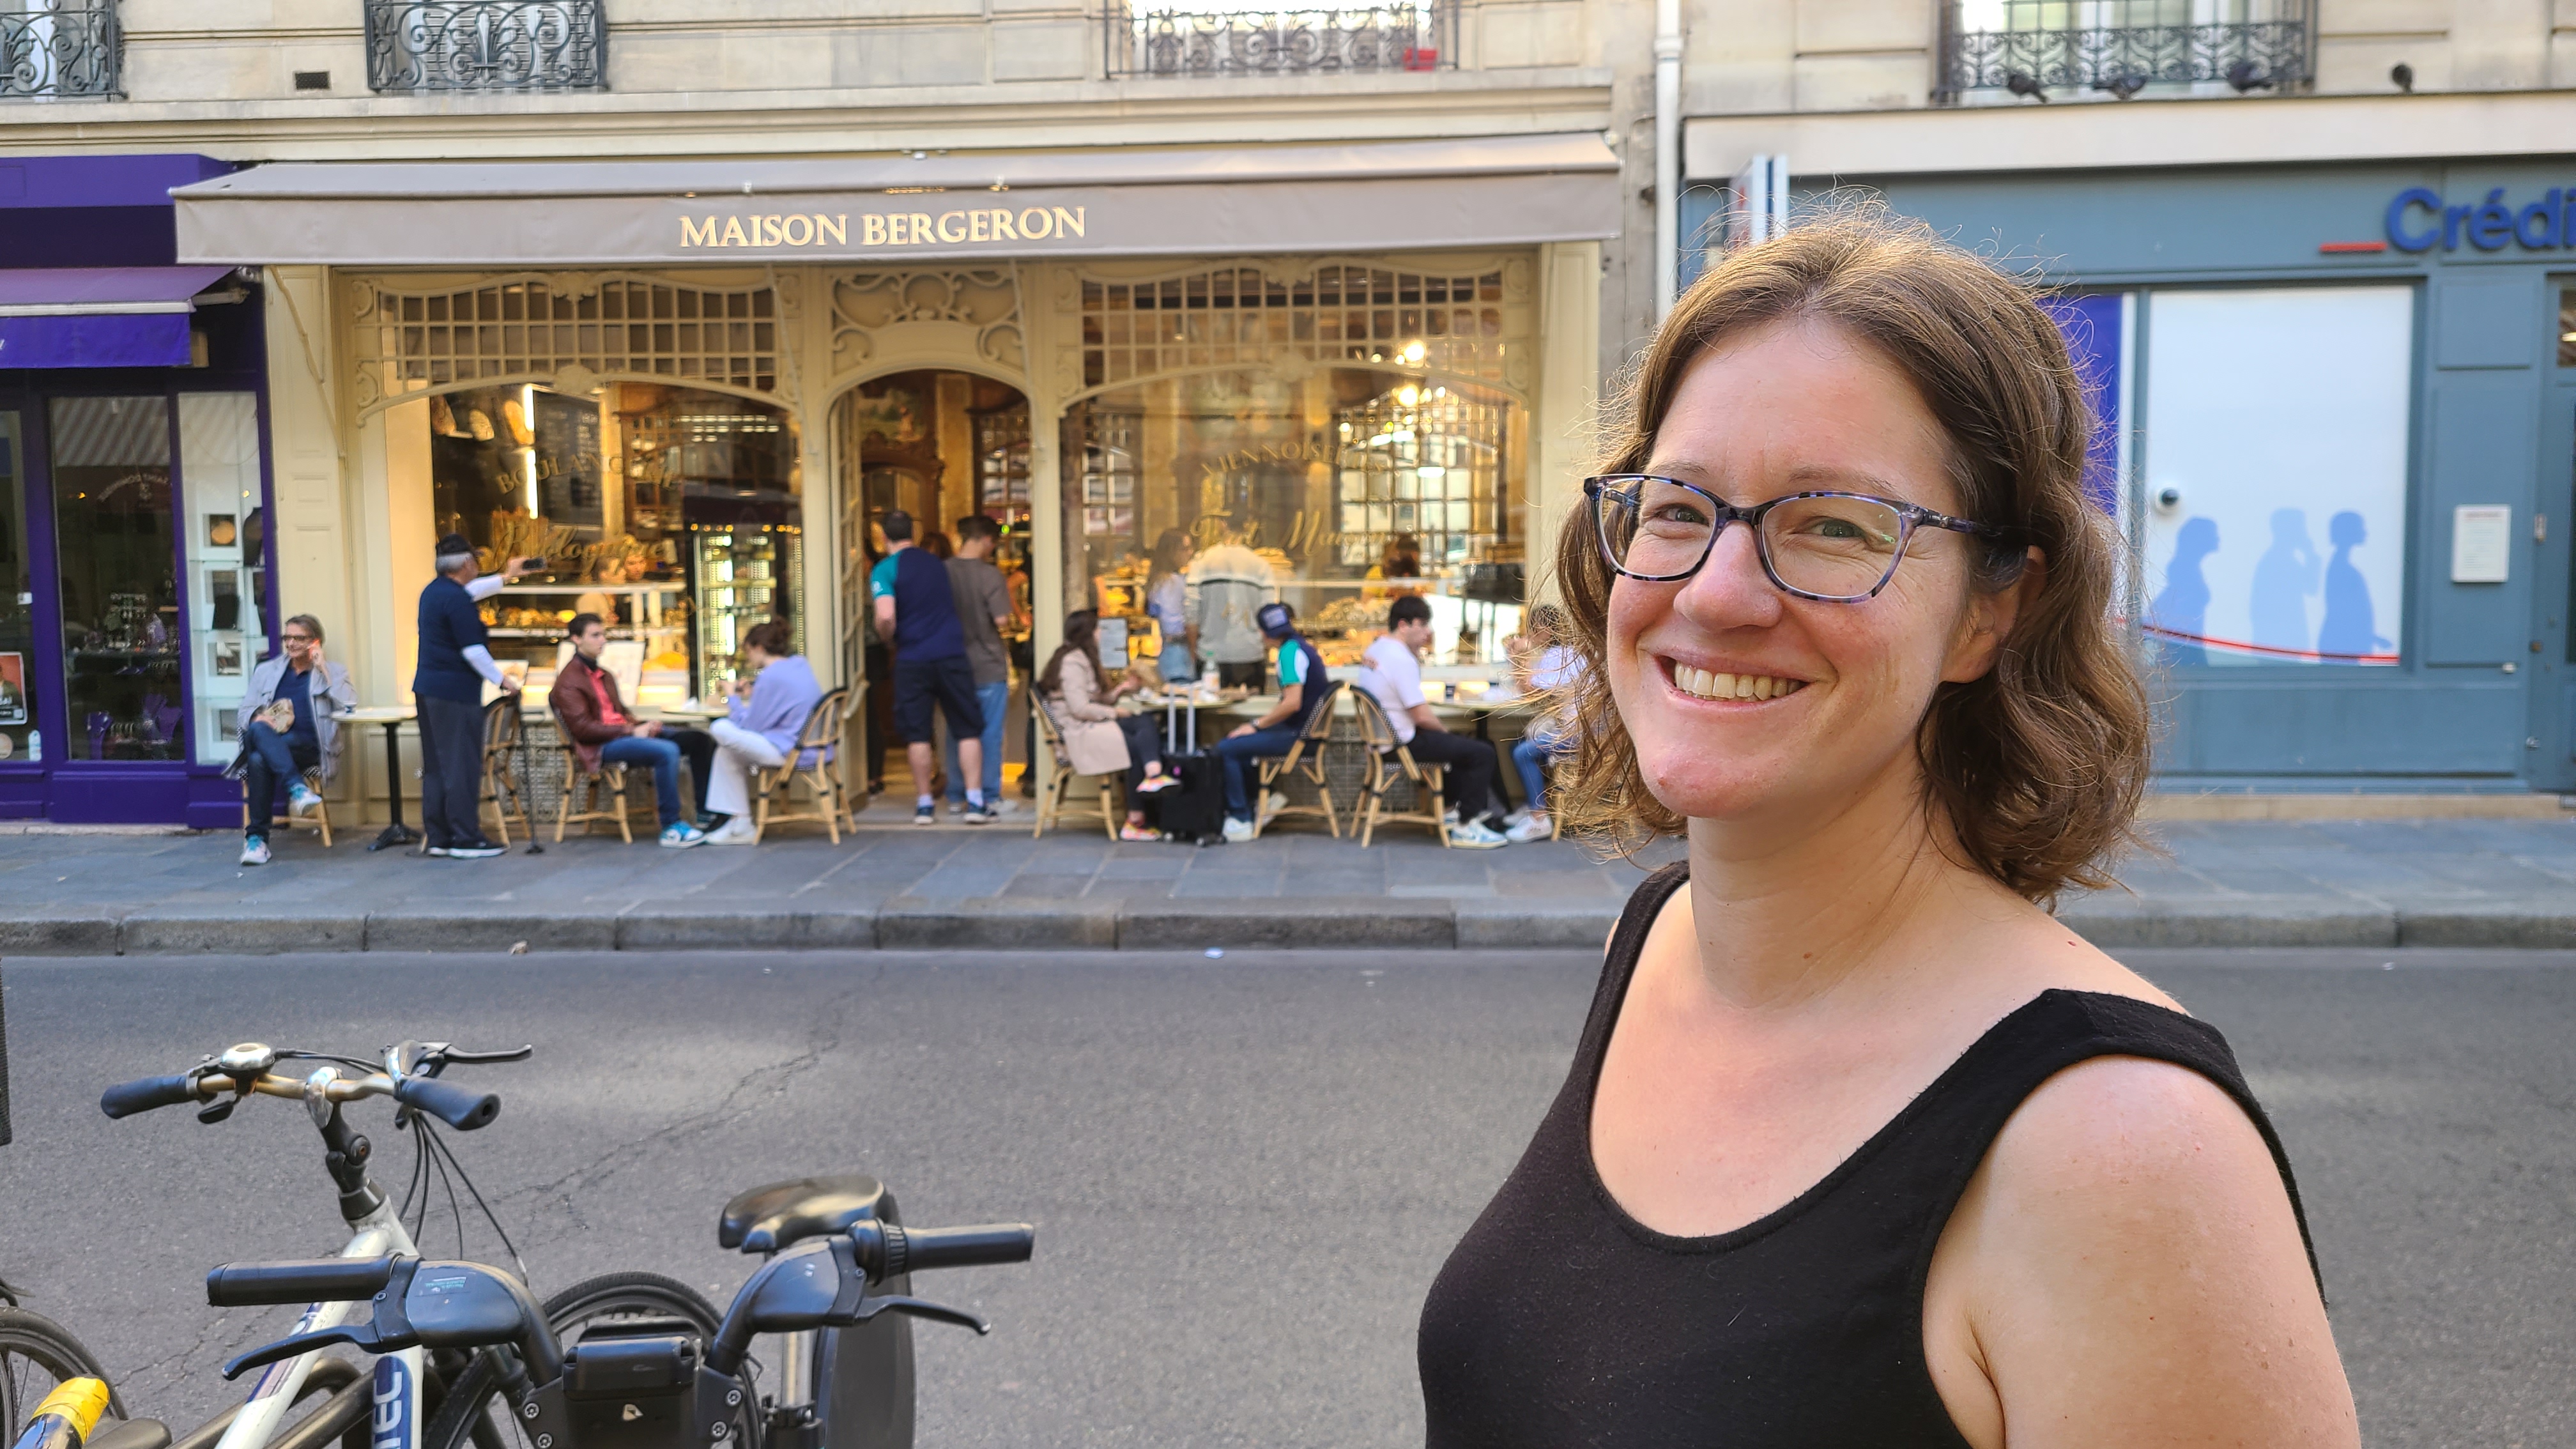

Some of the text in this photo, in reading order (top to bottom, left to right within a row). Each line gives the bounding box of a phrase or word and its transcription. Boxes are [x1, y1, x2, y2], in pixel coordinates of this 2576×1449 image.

[678, 206, 1085, 247] MAISON BERGERON
[2386, 188, 2576, 252] Crédi
